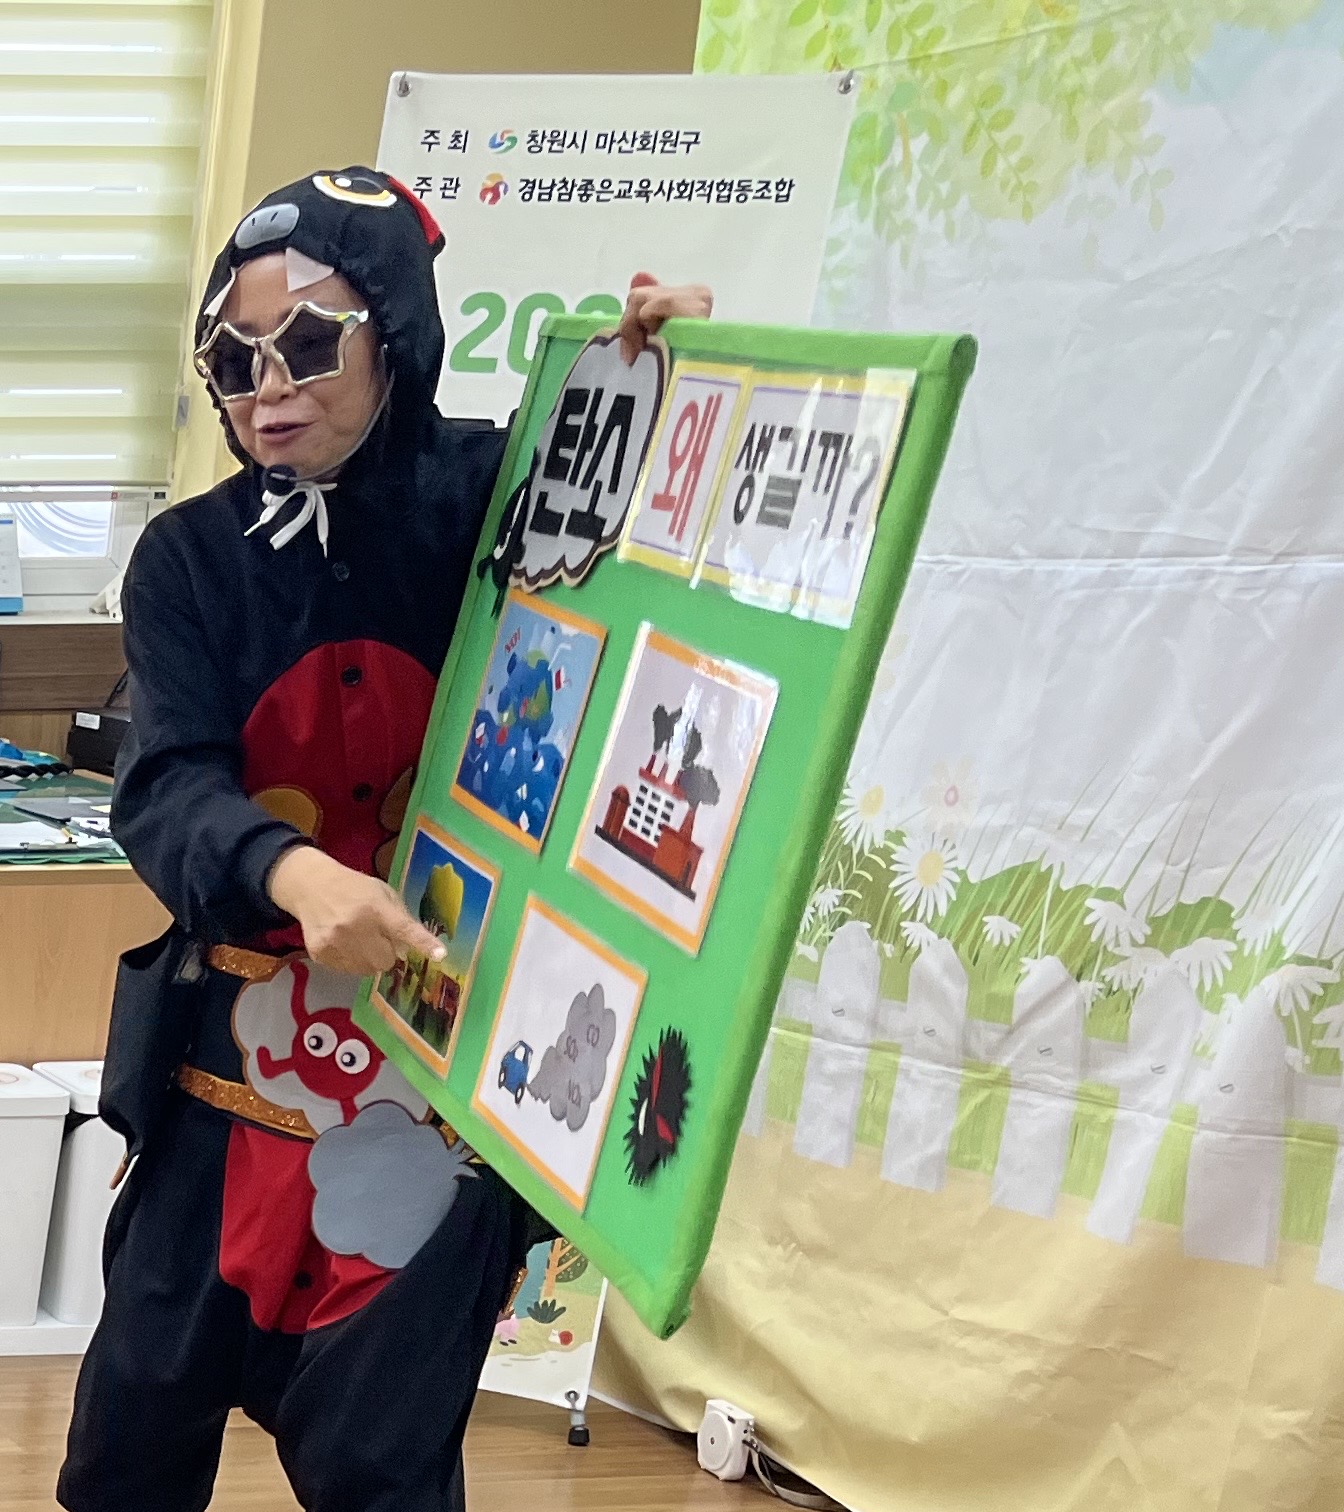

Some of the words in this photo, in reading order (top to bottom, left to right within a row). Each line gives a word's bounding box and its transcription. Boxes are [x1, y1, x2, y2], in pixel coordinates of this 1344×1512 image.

[525, 129, 588, 154] 창원시
[595, 129, 702, 155] 마산회원구
[518, 177, 796, 205] 경남참좋은교육사회적협동조합
[449, 291, 623, 376] 20
[528, 387, 636, 543] 탄소
[651, 392, 724, 543] 왜
[734, 421, 880, 541] 생길까?
